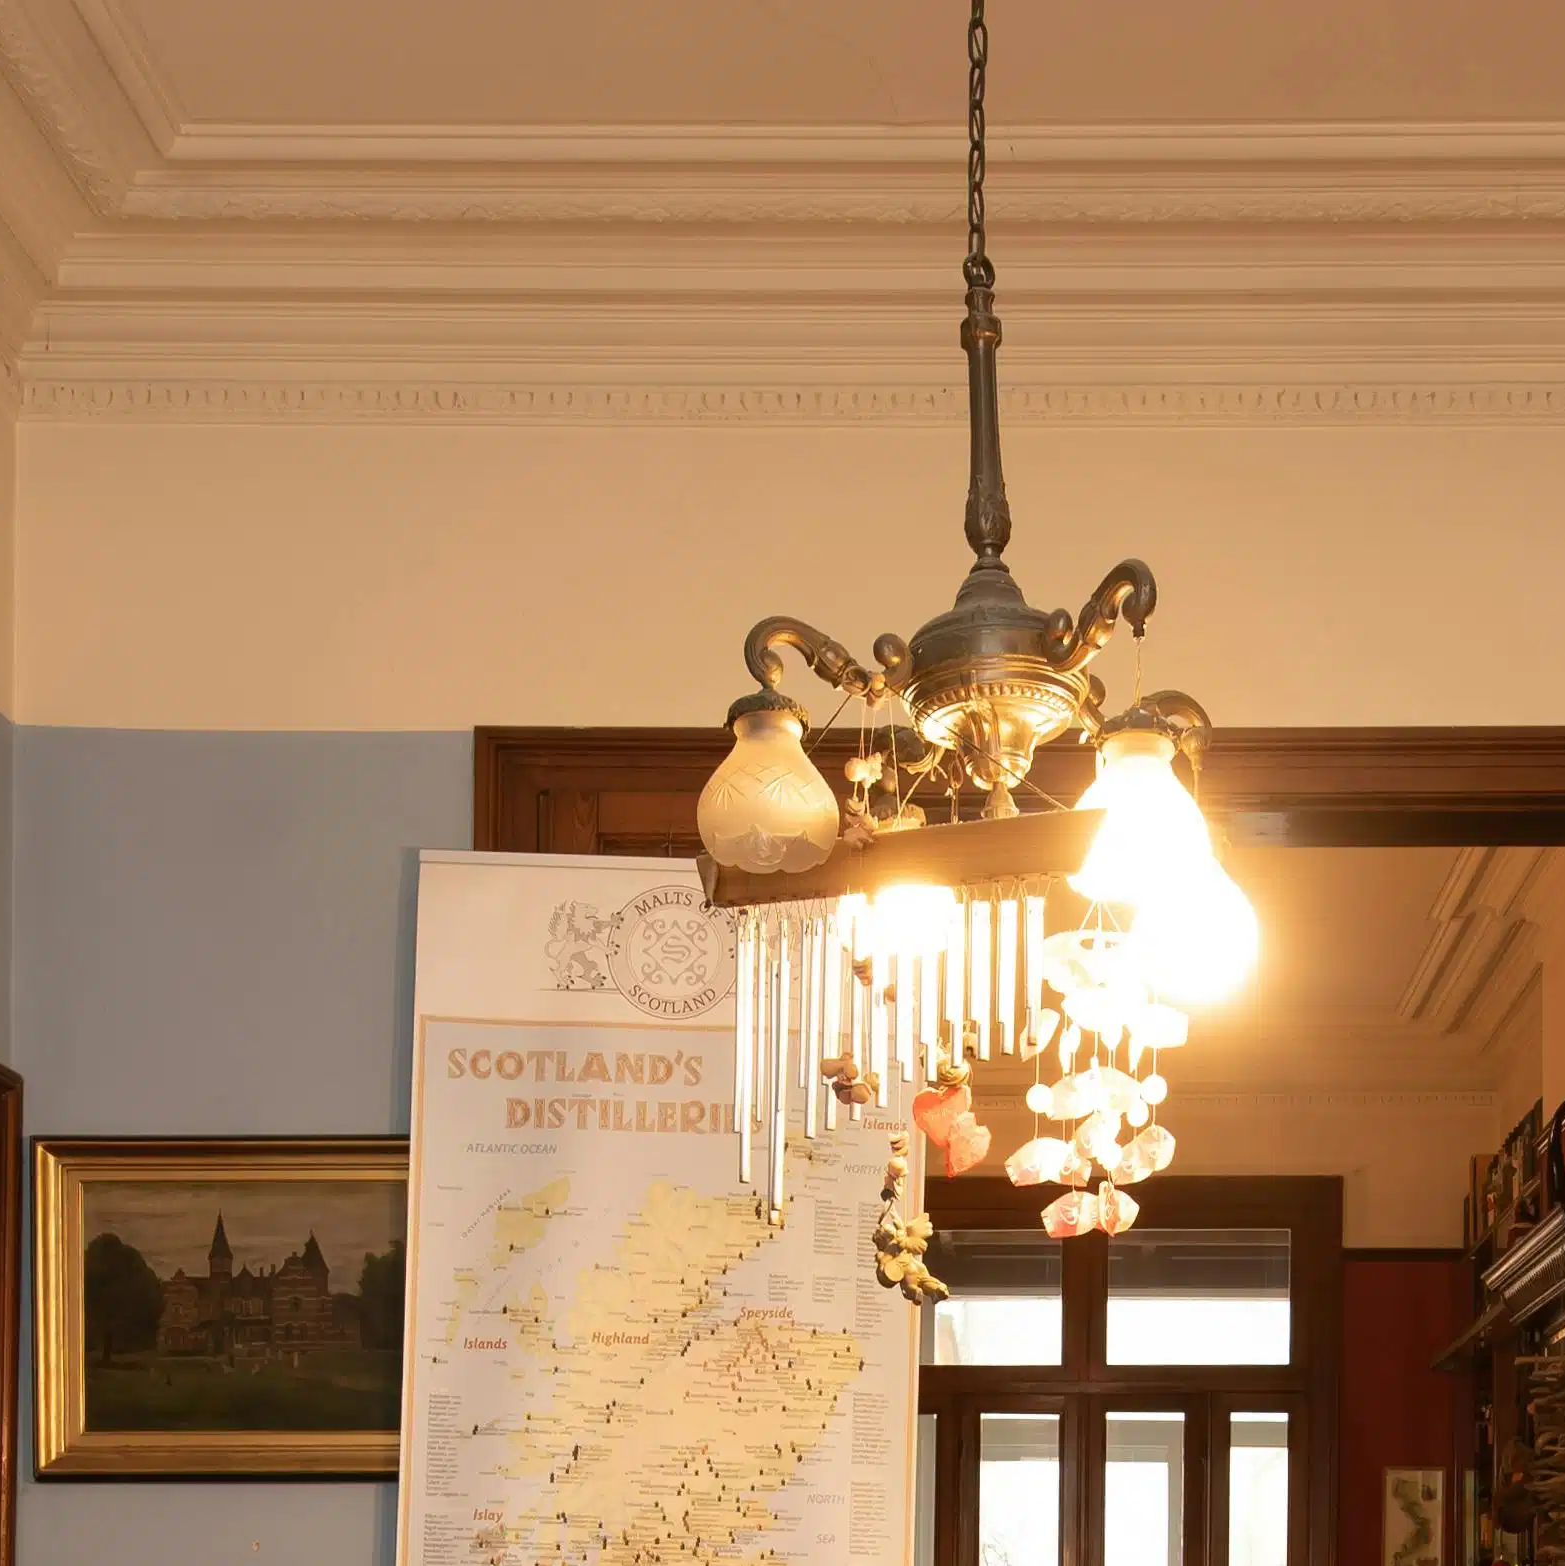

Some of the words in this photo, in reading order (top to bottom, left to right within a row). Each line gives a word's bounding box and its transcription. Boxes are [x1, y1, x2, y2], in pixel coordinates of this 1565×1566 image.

[634, 891, 693, 916] MALTS
[628, 984, 716, 1014] SCOTLAND
[447, 1048, 703, 1087] SCOTLAND'S
[466, 1143, 518, 1154] ATLANTIC
[520, 1144, 558, 1155] OCEAN
[740, 1306, 794, 1321] Speyside
[464, 1338, 508, 1350] Islands
[592, 1332, 650, 1347] Highland
[473, 1509, 503, 1523] Islay
[816, 1534, 835, 1544] SEA
